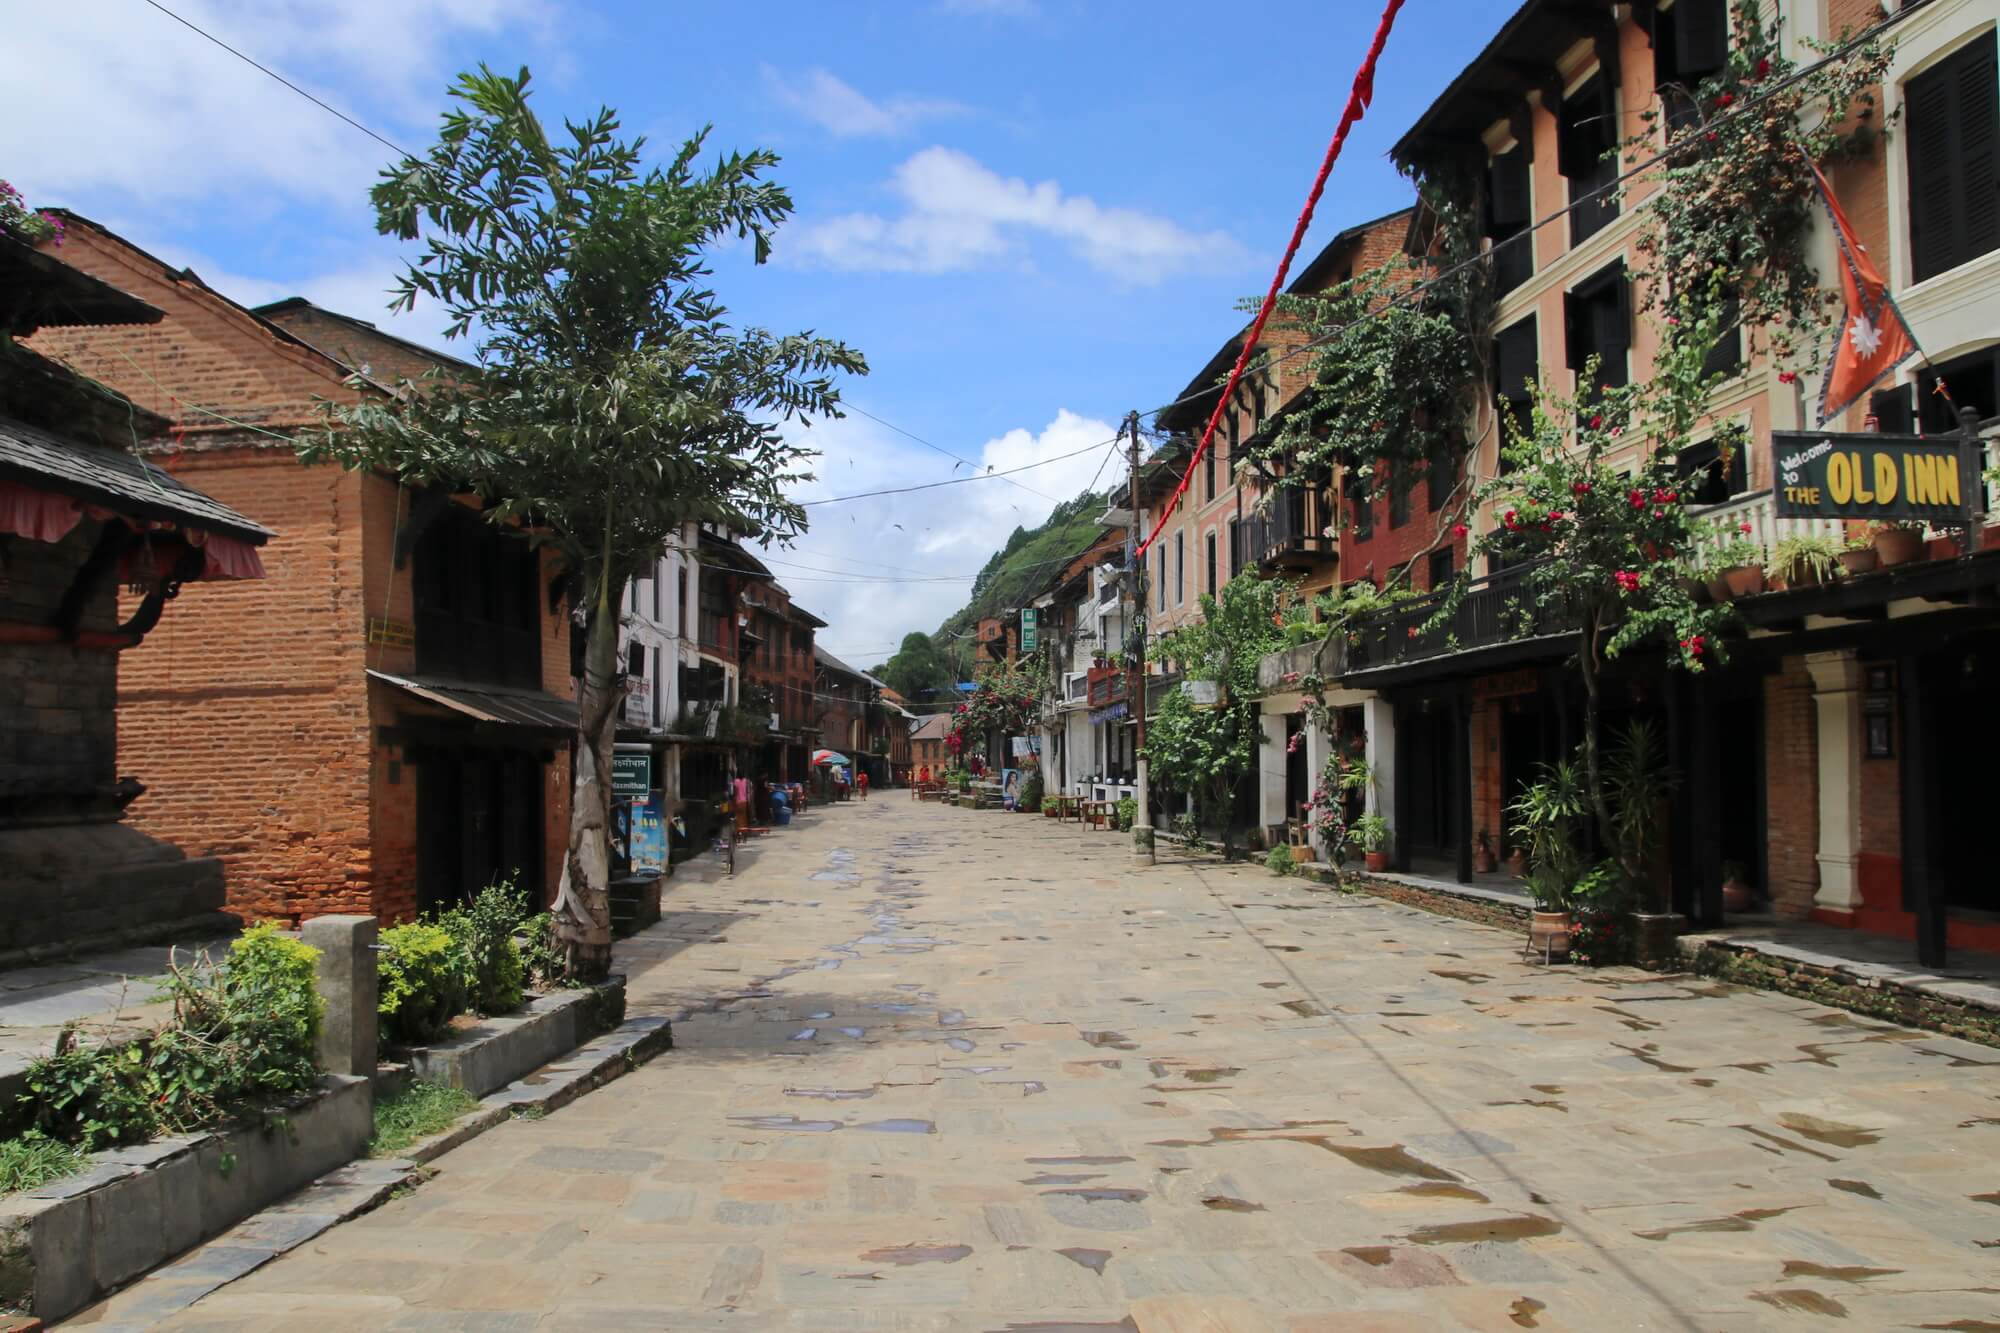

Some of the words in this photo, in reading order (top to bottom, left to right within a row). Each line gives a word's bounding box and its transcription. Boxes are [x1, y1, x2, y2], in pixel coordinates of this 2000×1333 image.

[1779, 438, 1833, 472] Welcome
[1782, 470, 1799, 485] to
[1826, 451, 1898, 506] OLD
[1903, 453, 1961, 506] INN
[1784, 486, 1821, 505] THE
